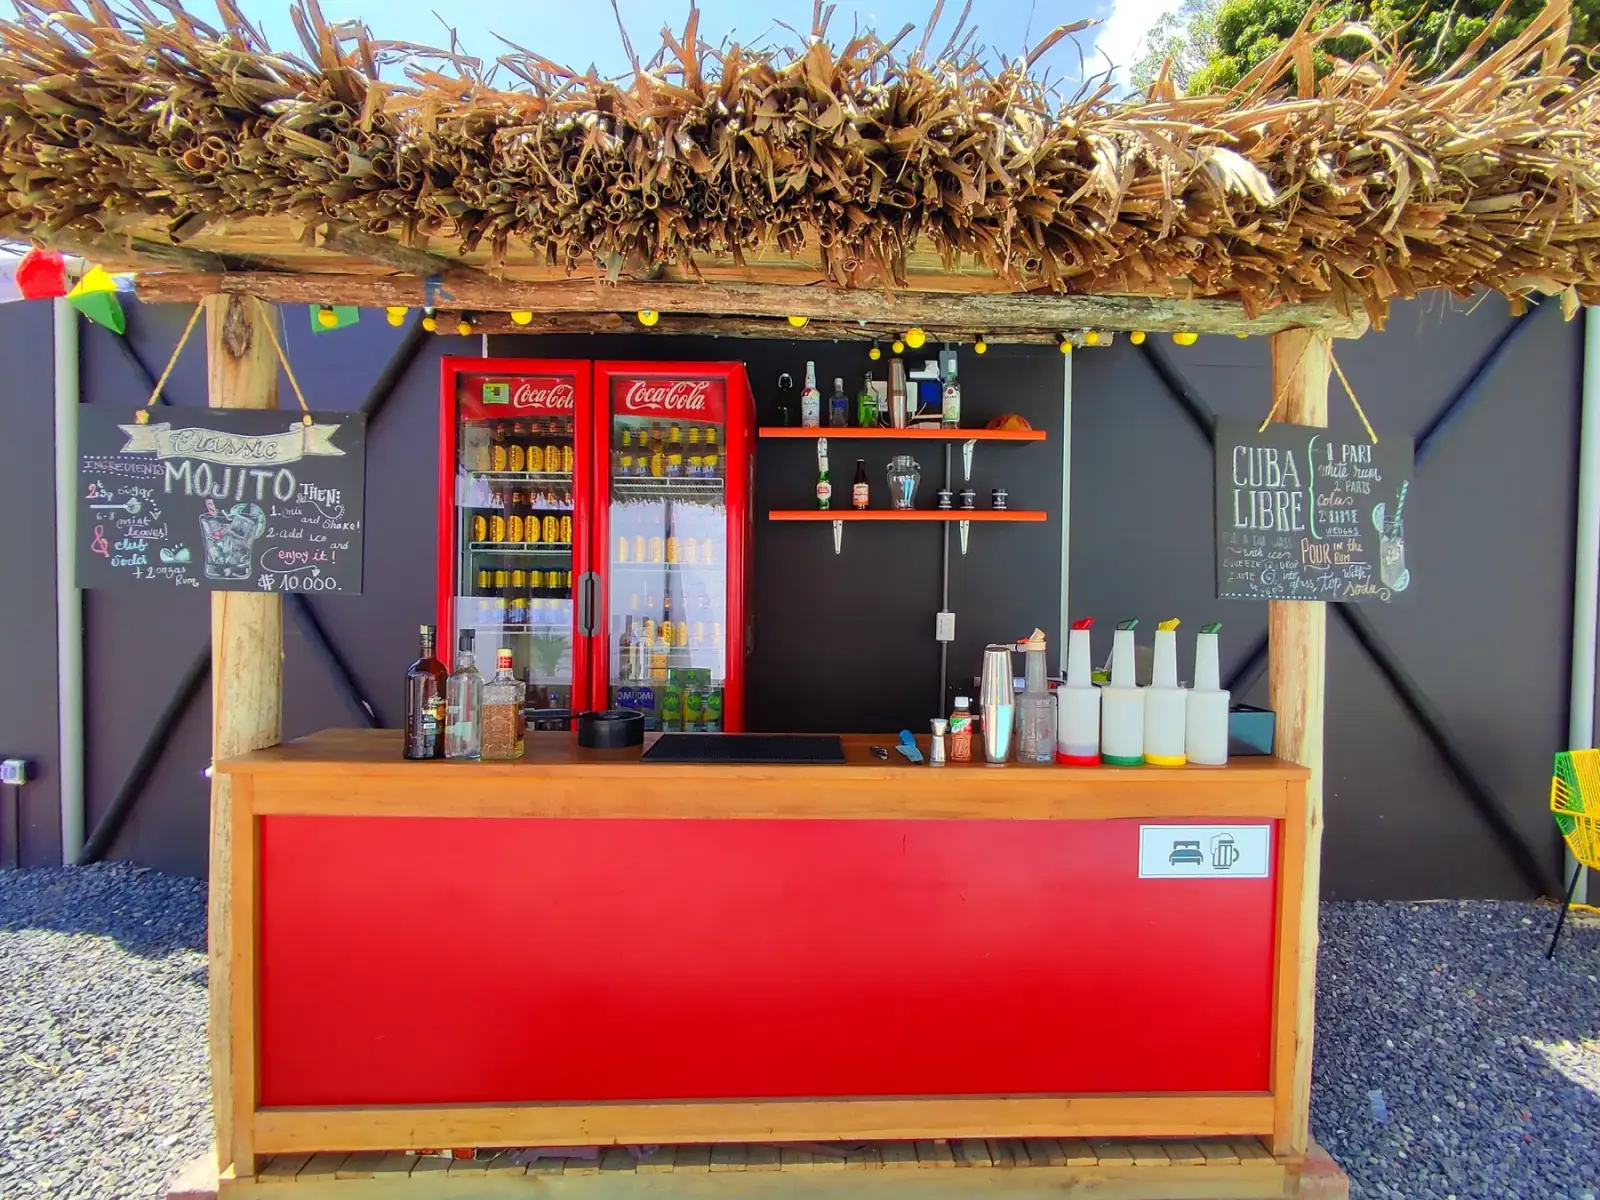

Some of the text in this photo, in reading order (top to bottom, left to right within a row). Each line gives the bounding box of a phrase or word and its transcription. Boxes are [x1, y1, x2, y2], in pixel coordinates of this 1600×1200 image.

[625, 380, 710, 409] Coca-Cola
[169, 430, 278, 459] Classic
[1342, 444, 1373, 463] PART
[83, 460, 165, 475] INGREDIENTS
[1232, 445, 1302, 488] CUBA
[164, 460, 296, 502] MOJITO
[1333, 480, 1371, 495] 2 PARTS
[301, 515, 321, 524] and
[1232, 488, 1305, 532] LIBRE
[330, 541, 350, 550] and
[278, 550, 309, 565] enjoy
